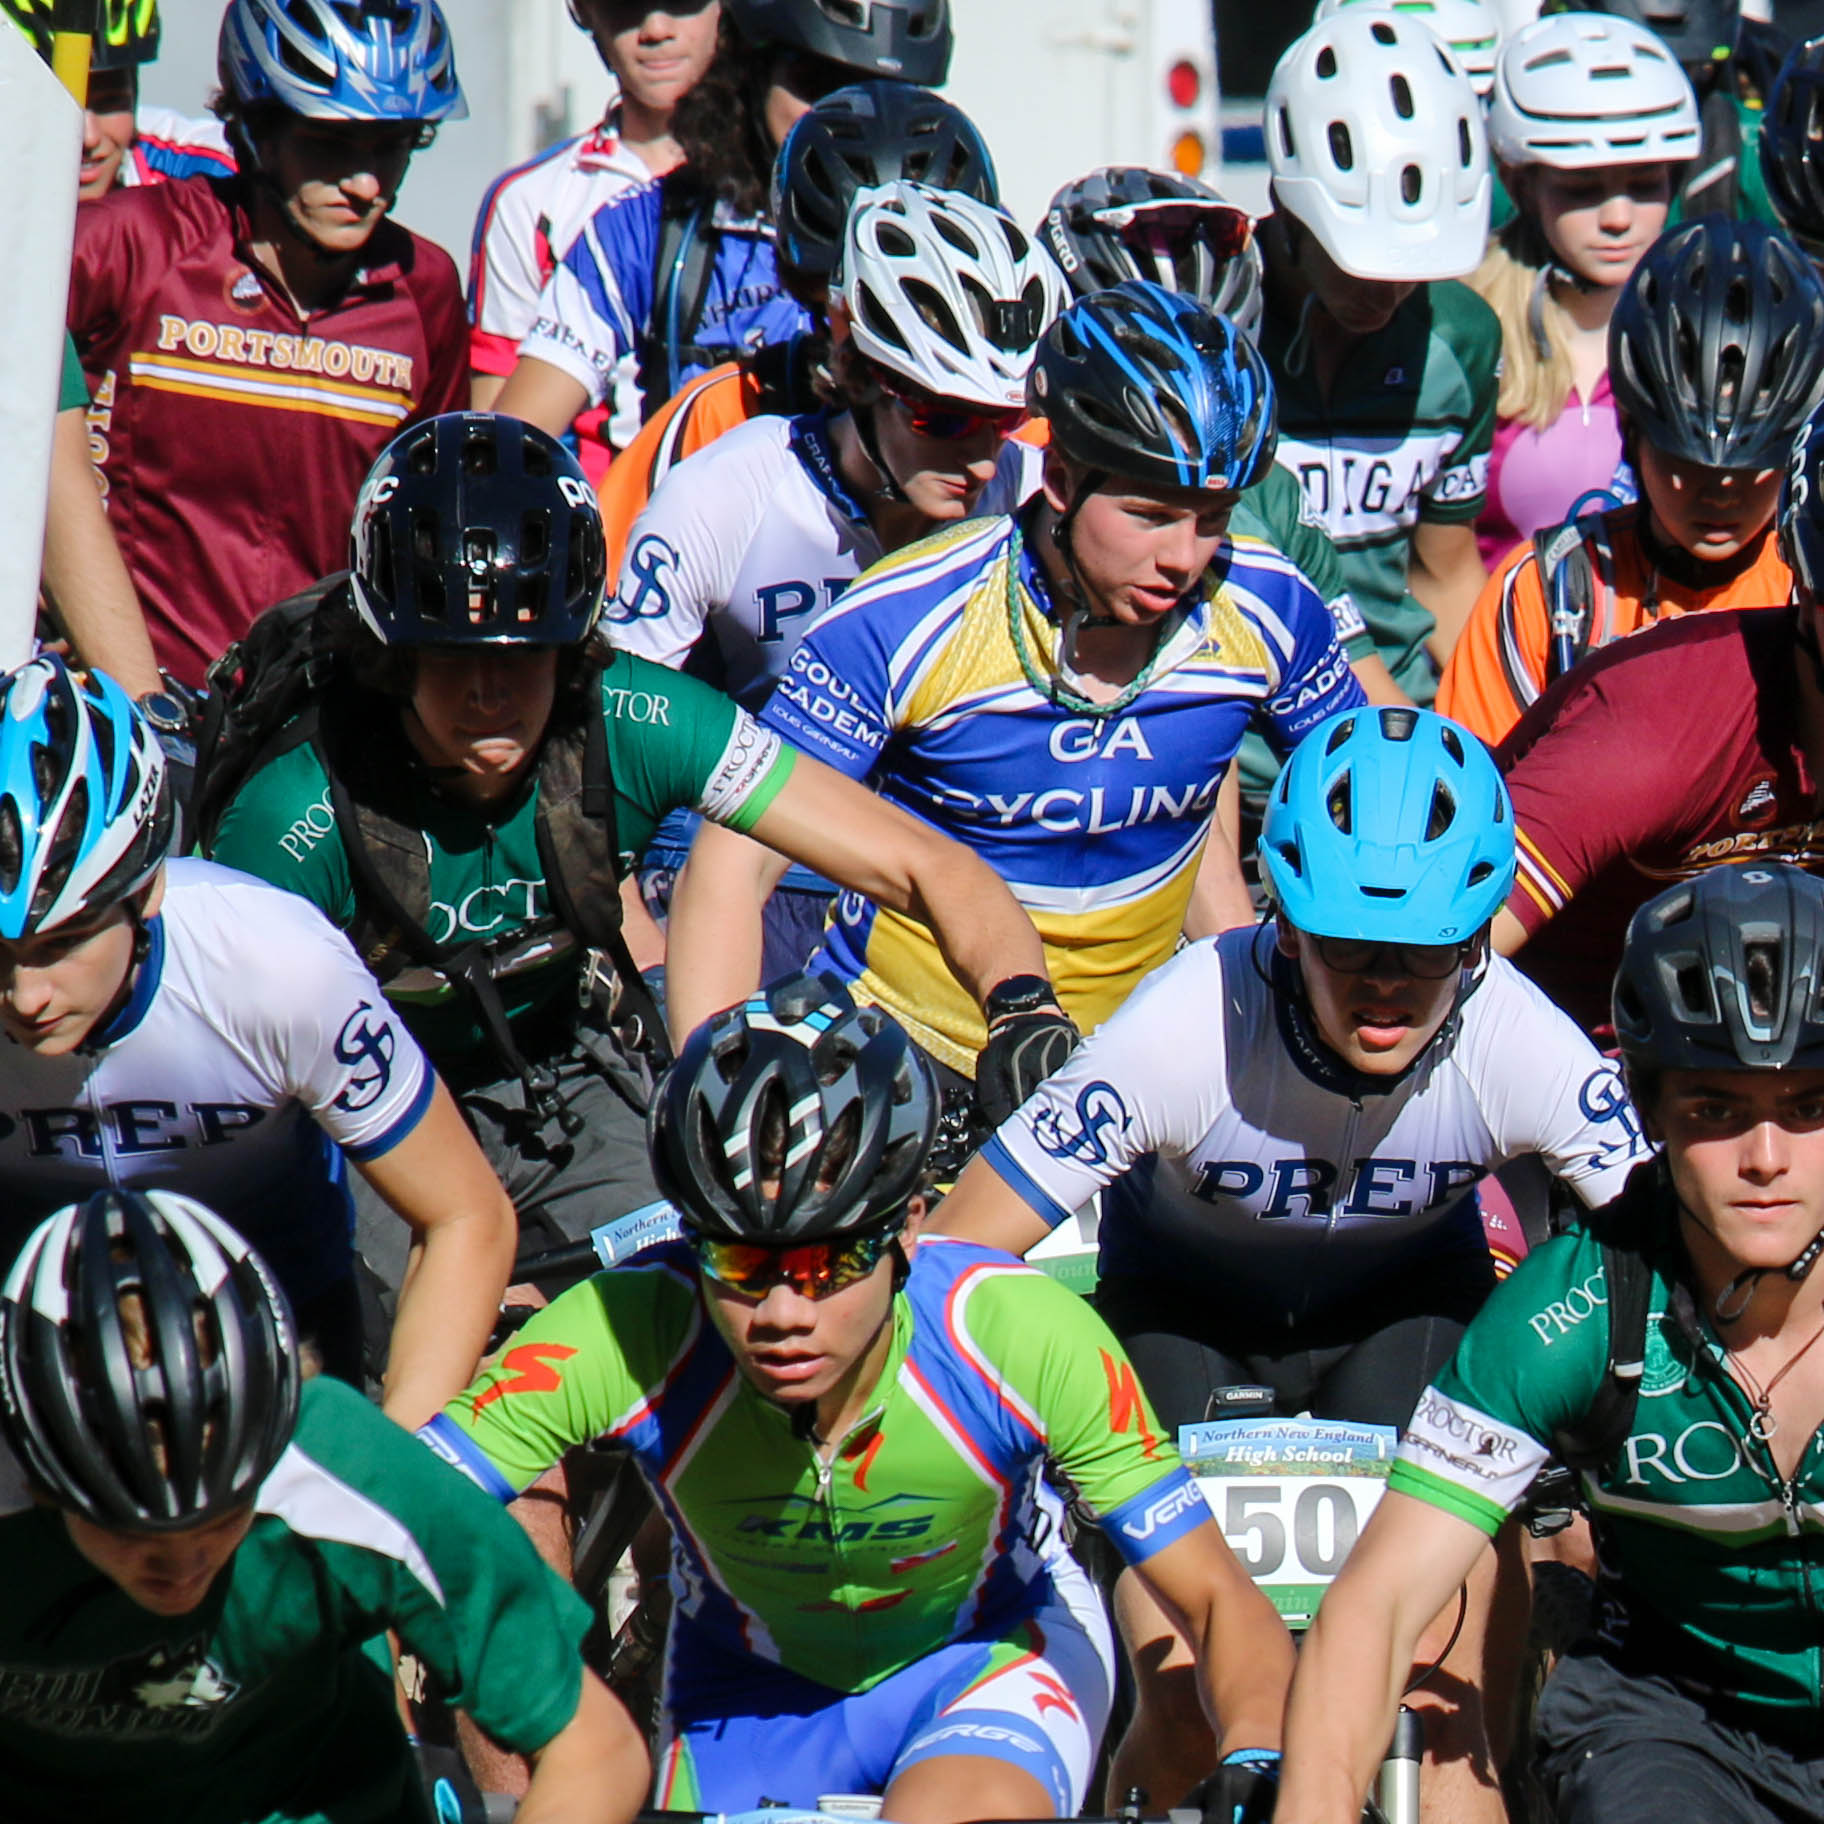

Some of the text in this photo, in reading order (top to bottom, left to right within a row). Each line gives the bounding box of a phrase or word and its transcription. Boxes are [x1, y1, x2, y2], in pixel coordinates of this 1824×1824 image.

[160, 314, 413, 391] PORTSMOUTH
[1049, 718, 1153, 764] GA
[131, 765, 165, 830] LAZER
[1195, 1158, 1487, 1220] PREP
[1225, 1390, 1264, 1401] GARMIN
[1224, 1441, 1354, 1465] High School
[1300, 1427, 1377, 1446] England
[735, 1512, 936, 1543] KMS
[1222, 1483, 1358, 1577] 50
